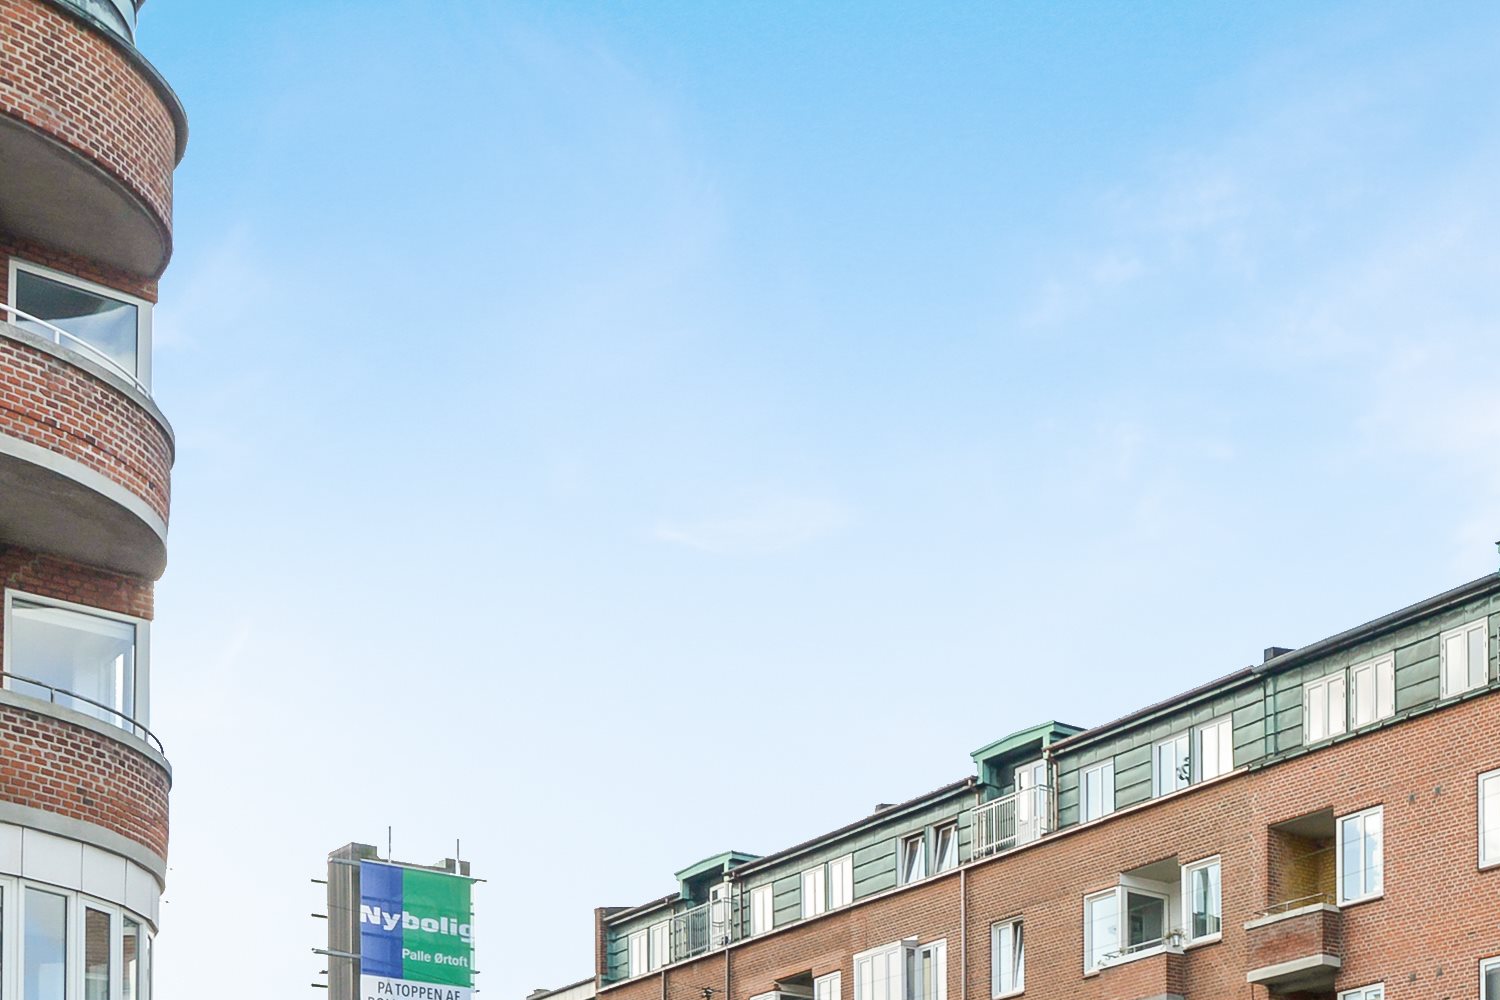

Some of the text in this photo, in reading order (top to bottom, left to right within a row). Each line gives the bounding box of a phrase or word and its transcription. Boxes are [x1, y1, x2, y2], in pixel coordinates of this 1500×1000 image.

[360, 904, 471, 944] Nybolig
[402, 948, 468, 967] Palle Ørtoft
[396, 983, 442, 1000] TOPPEN
